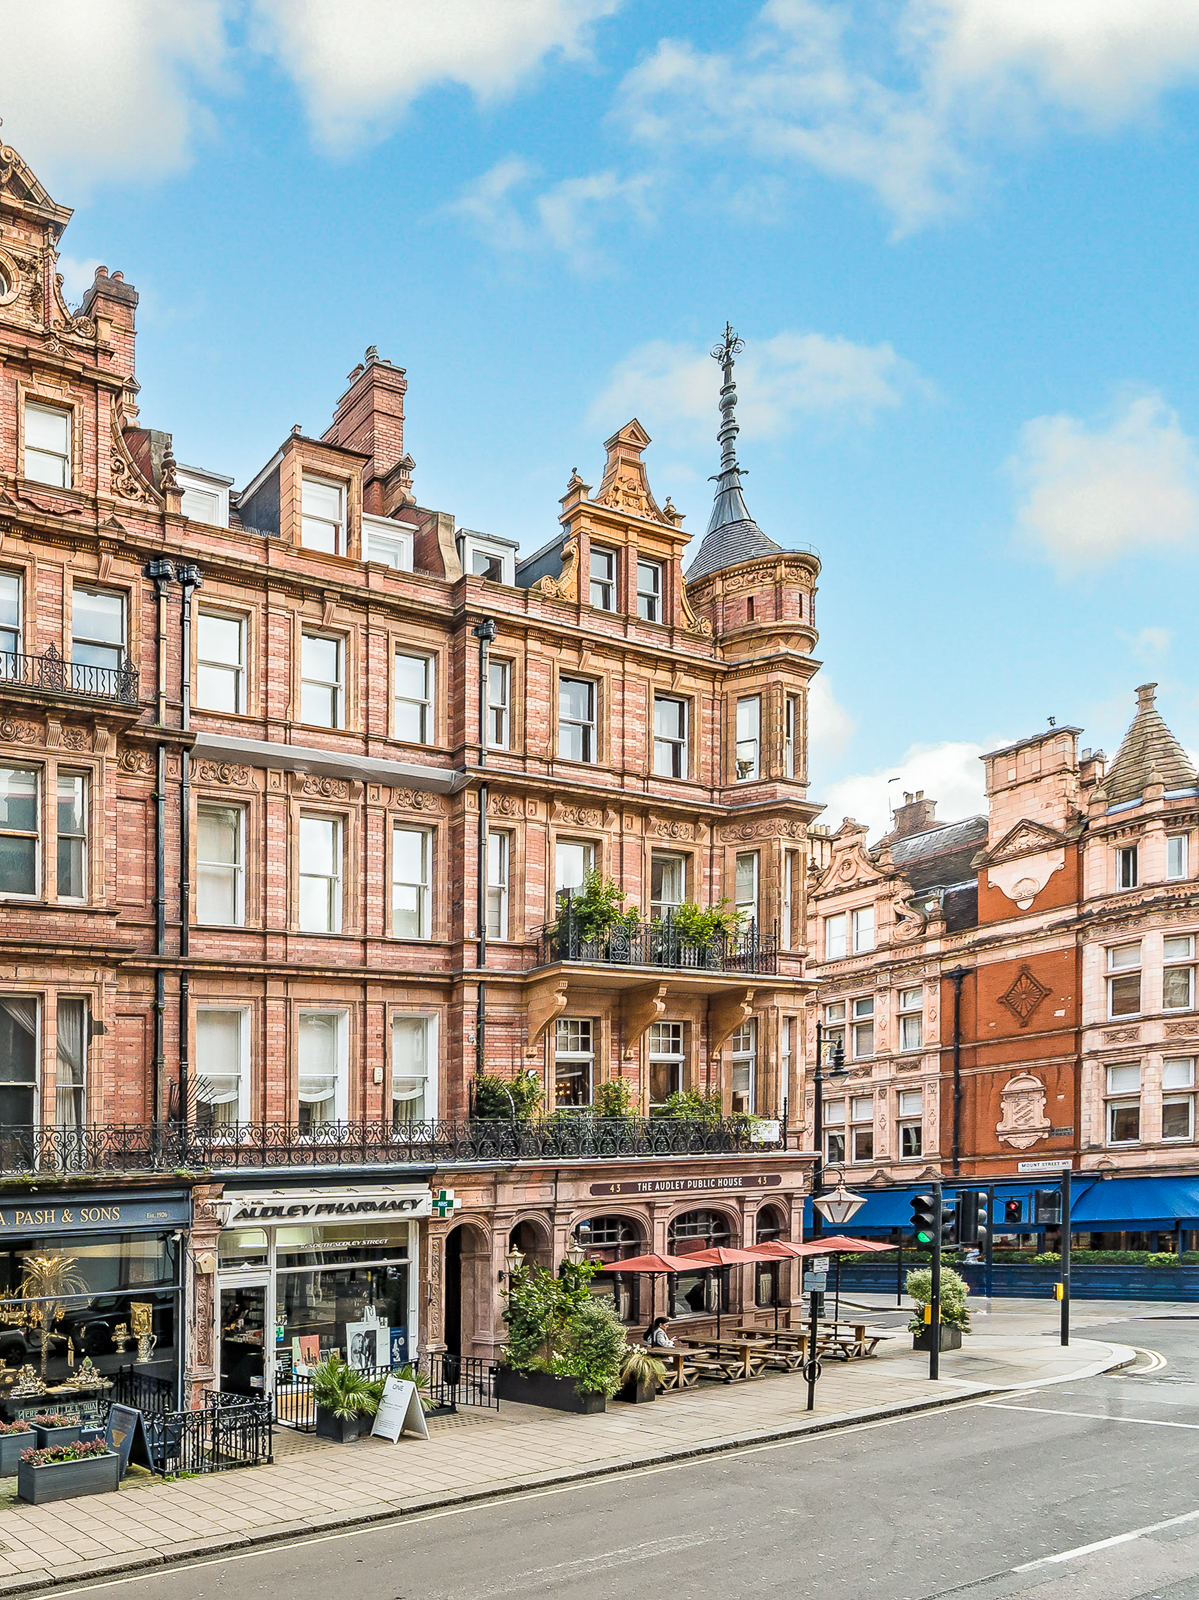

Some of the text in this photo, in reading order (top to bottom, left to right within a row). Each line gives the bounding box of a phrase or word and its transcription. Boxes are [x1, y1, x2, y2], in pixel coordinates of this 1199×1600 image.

[609, 1176, 768, 1193] 43 THE AUDLEY PUBLIC HOUSE 43
[15, 1209, 56, 1225] PASH
[61, 1208, 74, 1223] &
[79, 1207, 120, 1222] SONS
[232, 1198, 424, 1220] AUDLEY PHARMACY
[362, 1238, 389, 1246] STREET
[45, 1406, 60, 1416] YOU
[65, 1404, 80, 1413] GET
